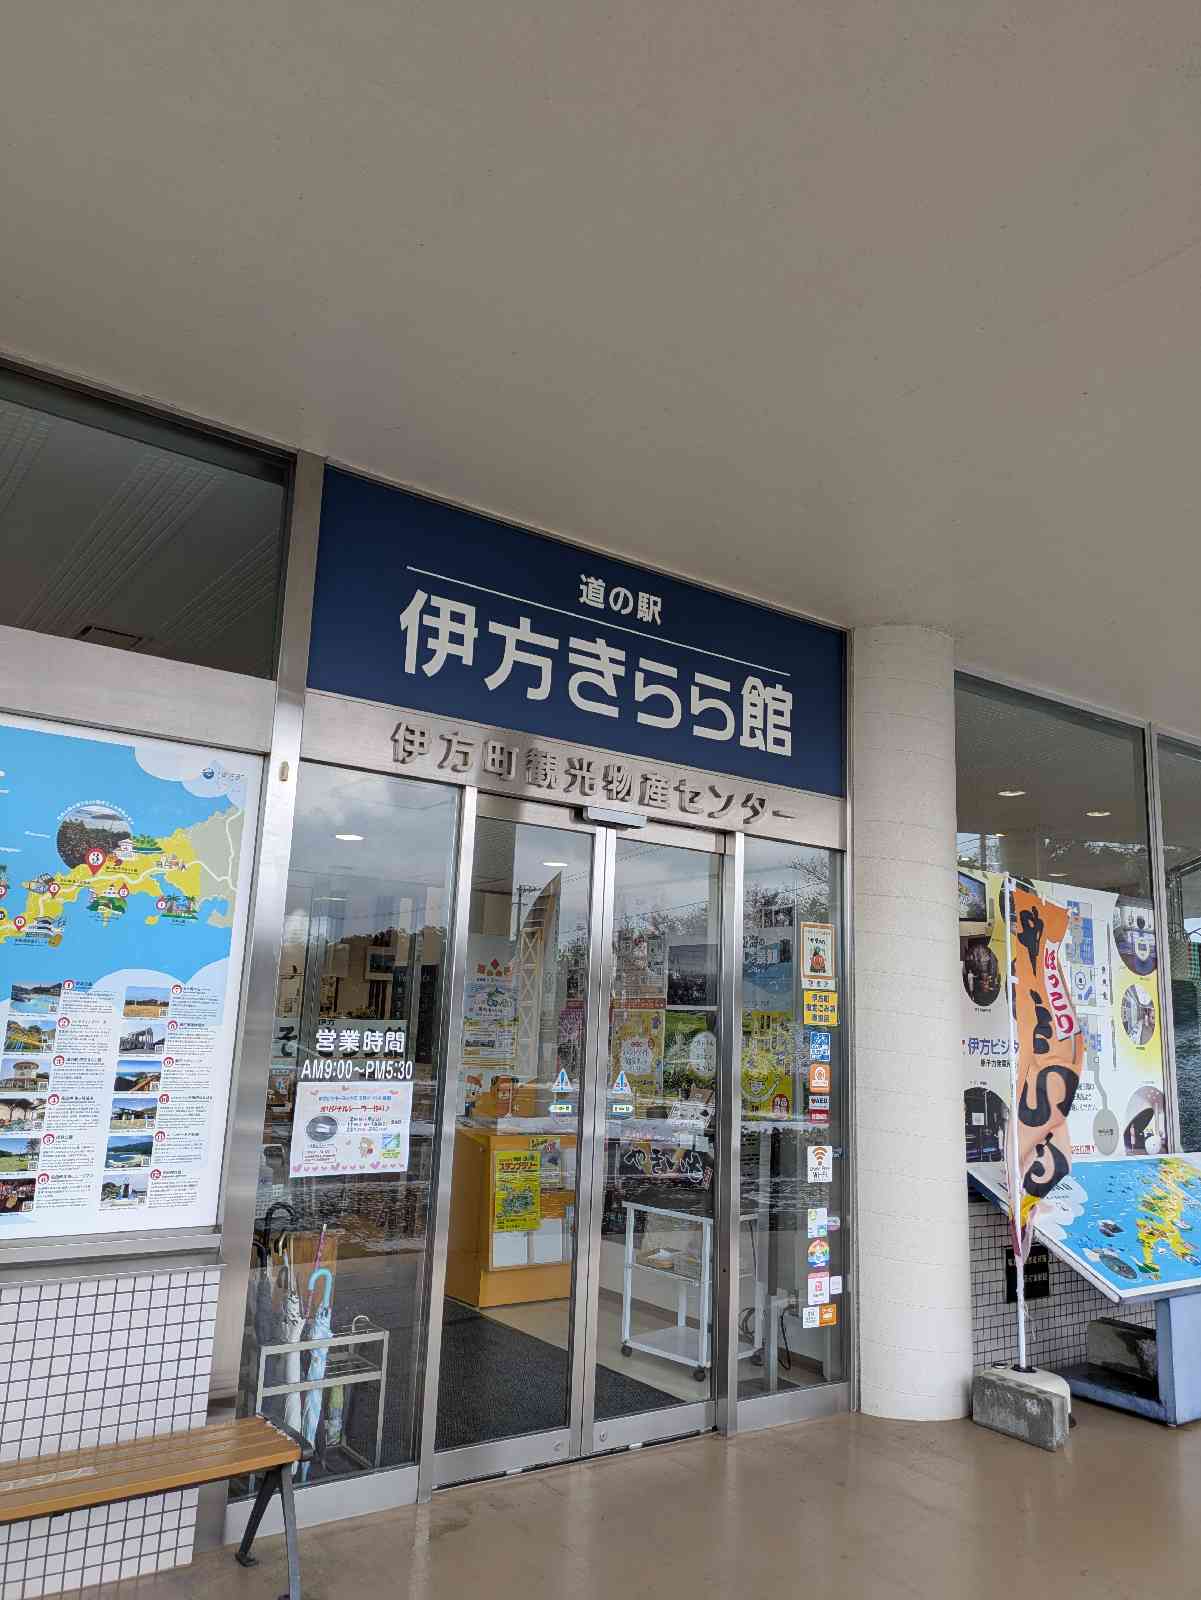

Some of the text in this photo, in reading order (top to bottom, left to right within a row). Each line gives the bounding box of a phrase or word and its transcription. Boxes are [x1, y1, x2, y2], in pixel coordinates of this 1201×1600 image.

[578, 574, 663, 626] 道の駅
[400, 589, 793, 757] 伊方きらら館
[391, 722, 797, 823] 伊方町観光物産センター
[316, 1029, 404, 1052] 営業時間
